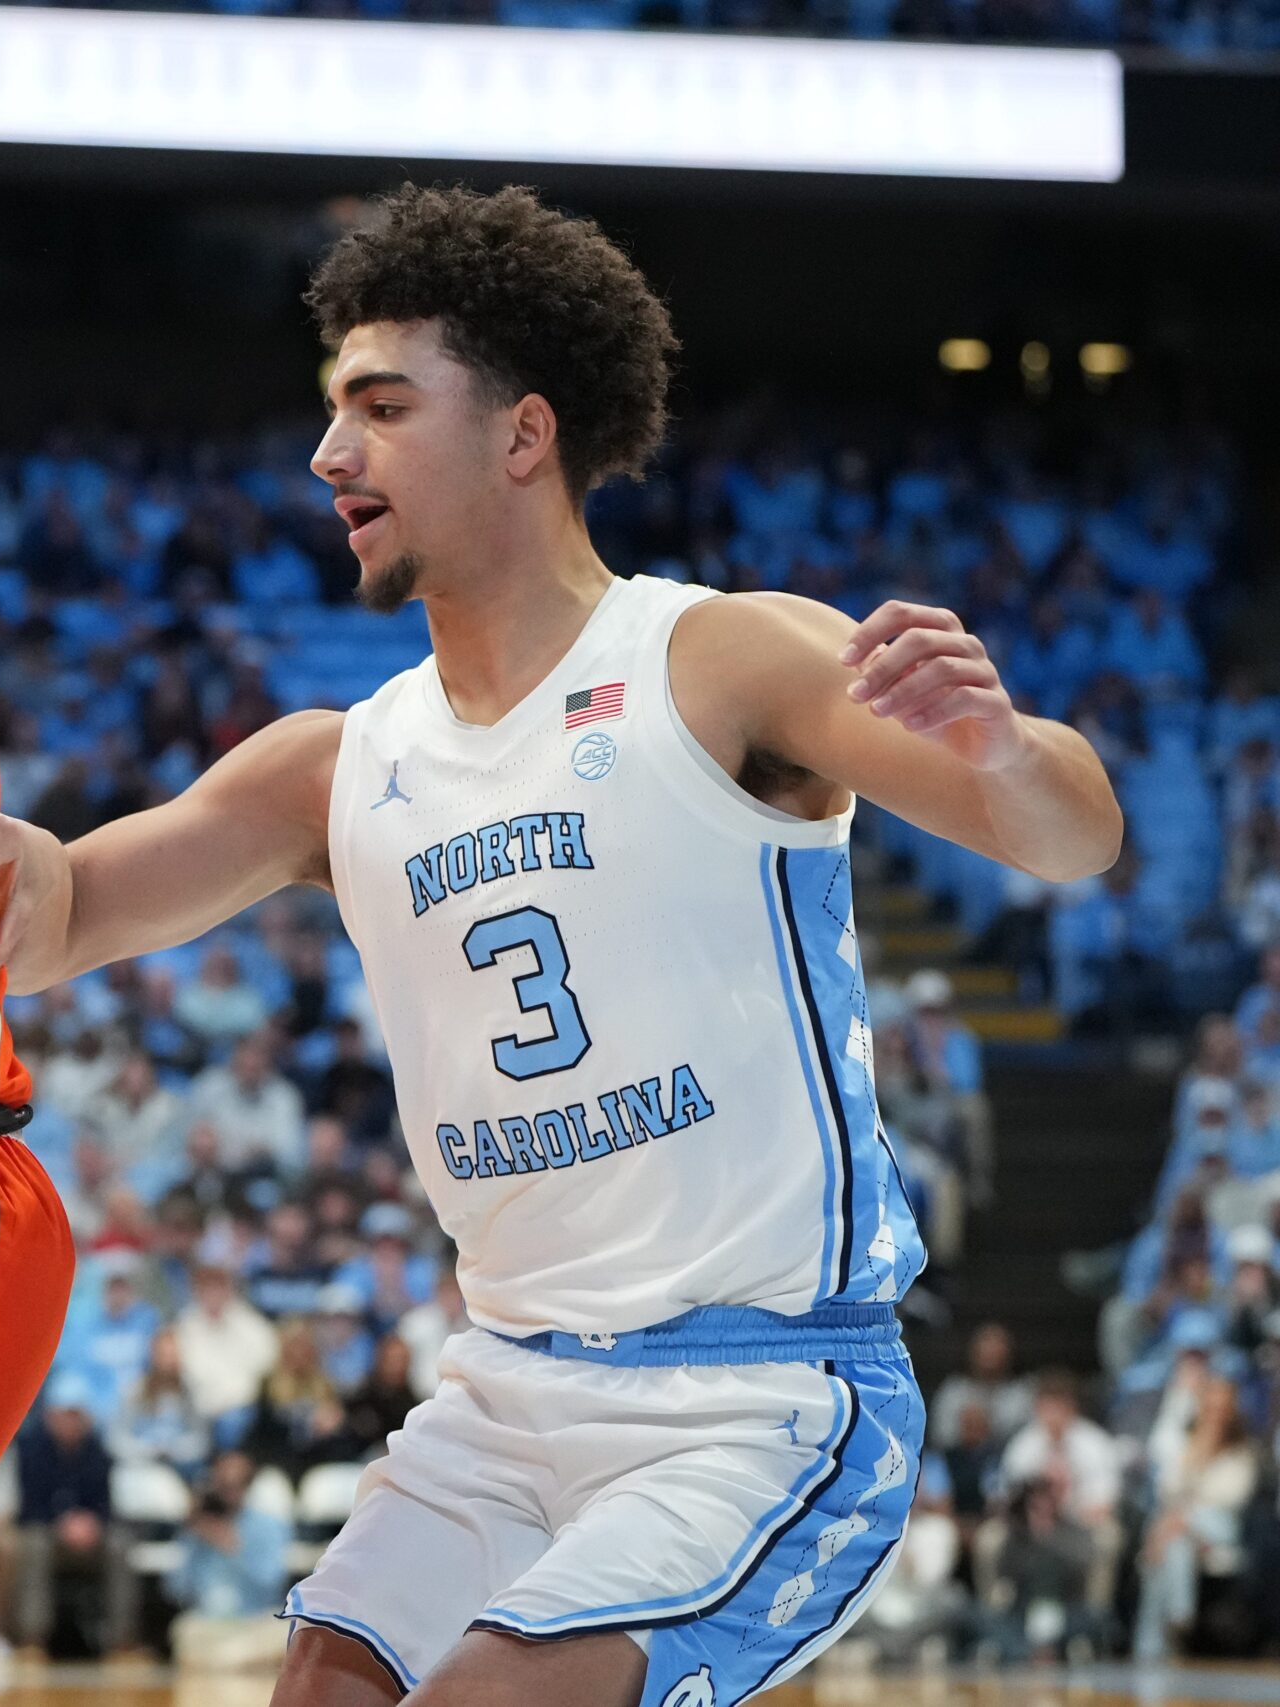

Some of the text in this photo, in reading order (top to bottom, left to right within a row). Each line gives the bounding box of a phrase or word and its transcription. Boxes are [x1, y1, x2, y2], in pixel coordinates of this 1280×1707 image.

[405, 812, 594, 917] NORTH
[462, 905, 592, 1081] 3
[436, 1064, 714, 1179] CAROLINA
